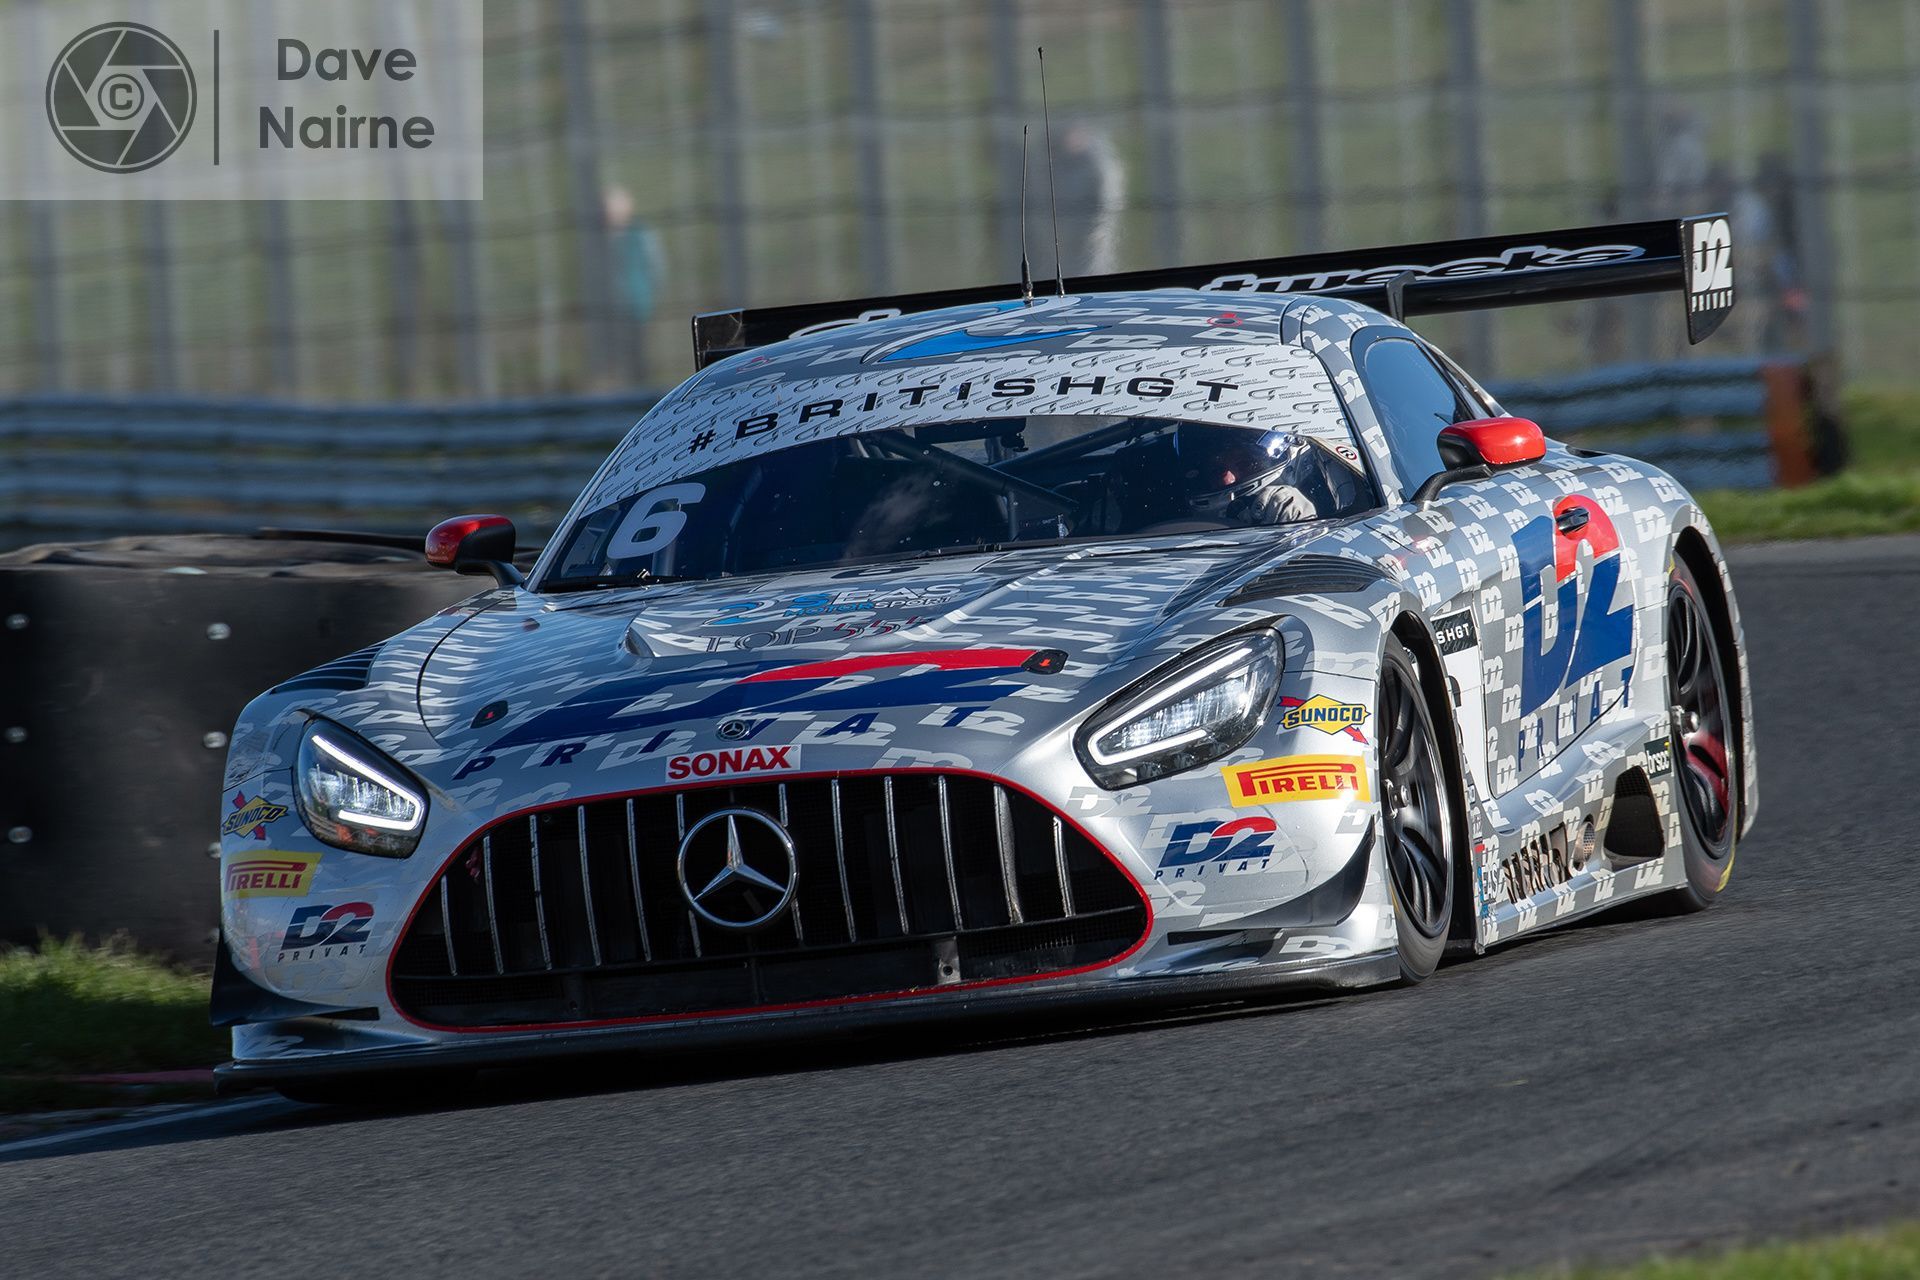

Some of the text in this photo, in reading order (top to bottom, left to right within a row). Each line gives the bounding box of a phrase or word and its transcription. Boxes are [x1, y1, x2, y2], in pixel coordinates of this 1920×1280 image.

[1692, 218, 1733, 293] D2
[606, 482, 706, 560] 6
[788, 583, 961, 609] SEAS
[1511, 492, 1634, 719] D2
[1288, 707, 1363, 726] SUNOCO
[668, 746, 792, 779] SONAX
[1236, 763, 1358, 797] PIRELLI
[226, 805, 282, 831] SUNOCO
[1158, 816, 1278, 868] D2
[225, 860, 307, 892] PIRELLI
[1154, 858, 1270, 880] PRIVAT
[281, 901, 375, 951] D2
[277, 944, 367, 963] PRIVAT
